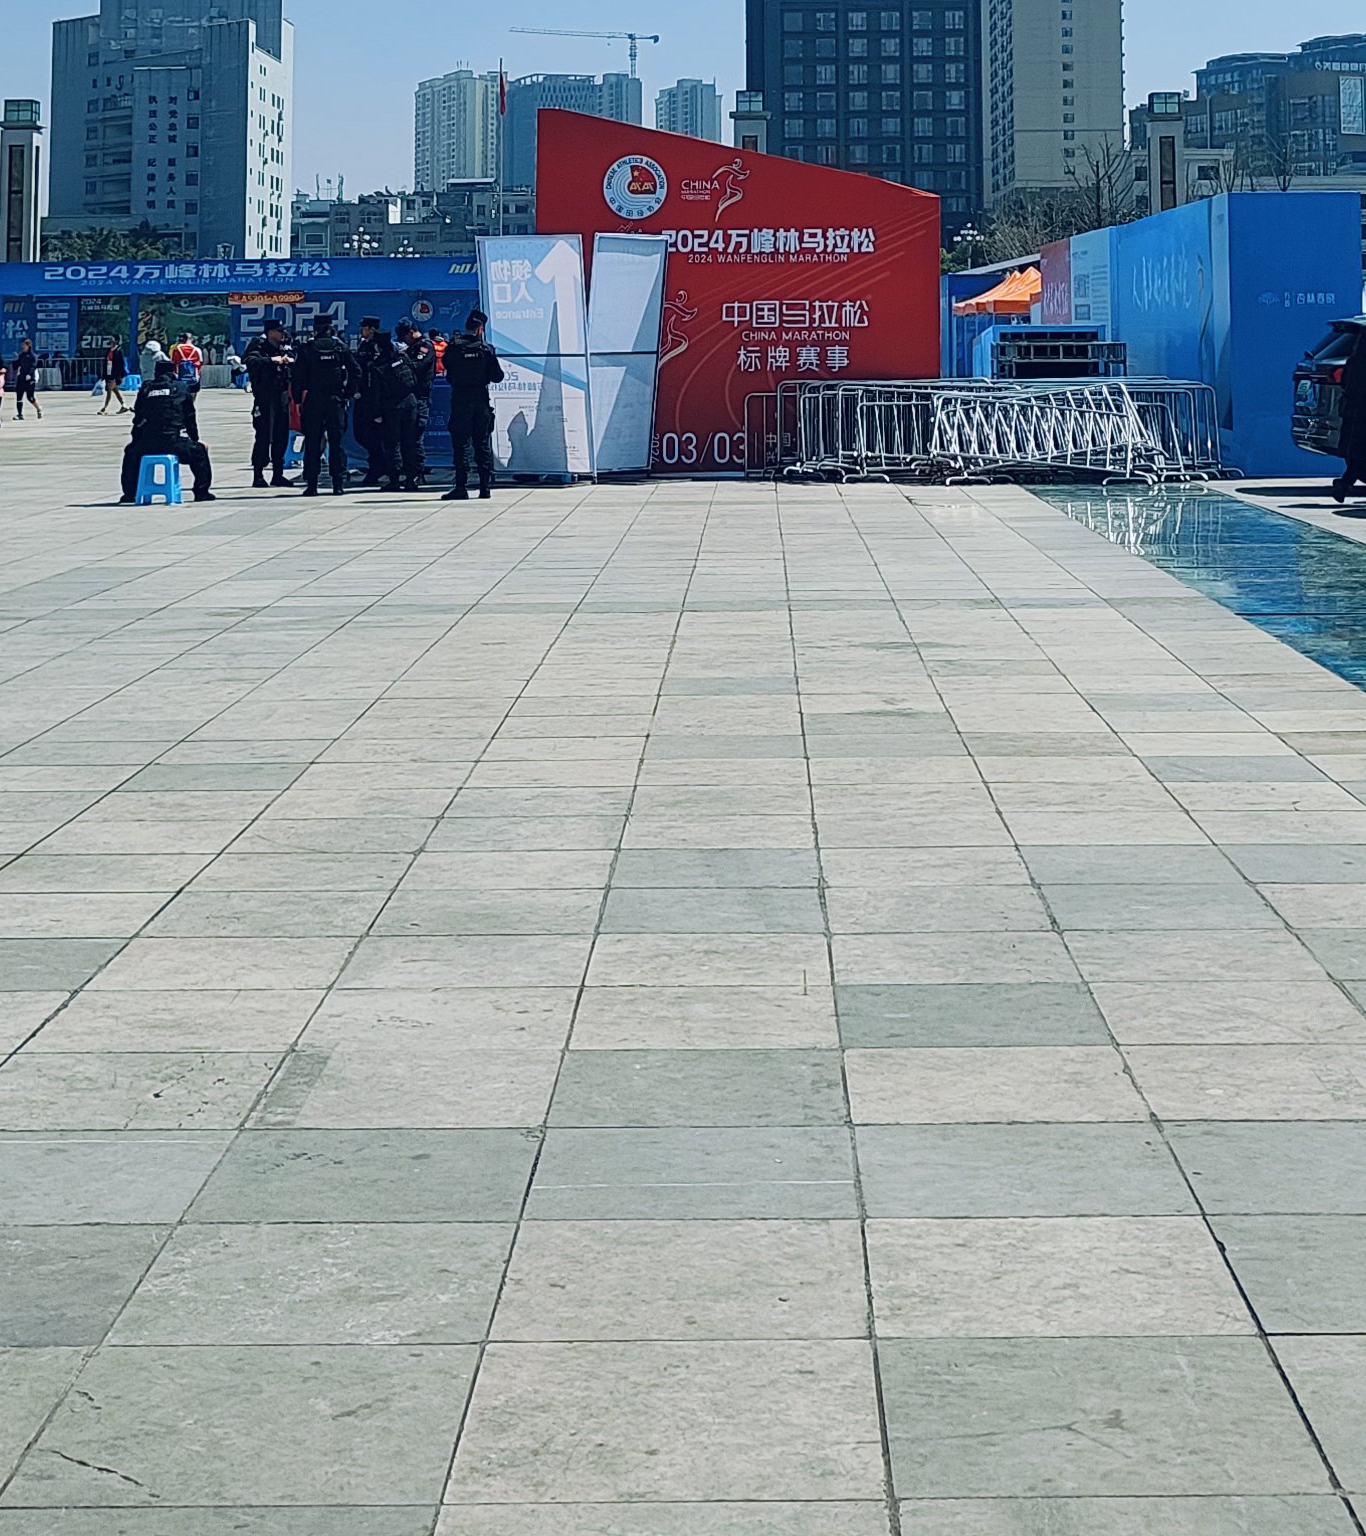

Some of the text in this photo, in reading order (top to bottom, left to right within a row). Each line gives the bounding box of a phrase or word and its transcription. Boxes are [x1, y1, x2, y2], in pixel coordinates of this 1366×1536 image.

[681, 180, 720, 190] CHINA
[662, 228, 875, 254] 2024万峰林马拉松
[688, 254, 849, 264] 2024 WANFENGLIN MARATHON
[43, 262, 331, 280] 2024万峰林马拉松
[120, 278, 211, 286] WANFENGLIN
[721, 300, 869, 328] 中国马拉松
[742, 331, 849, 342] CHINA MARATHON
[737, 344, 849, 372] 标牌赛事
[662, 432, 745, 464] 03/03
